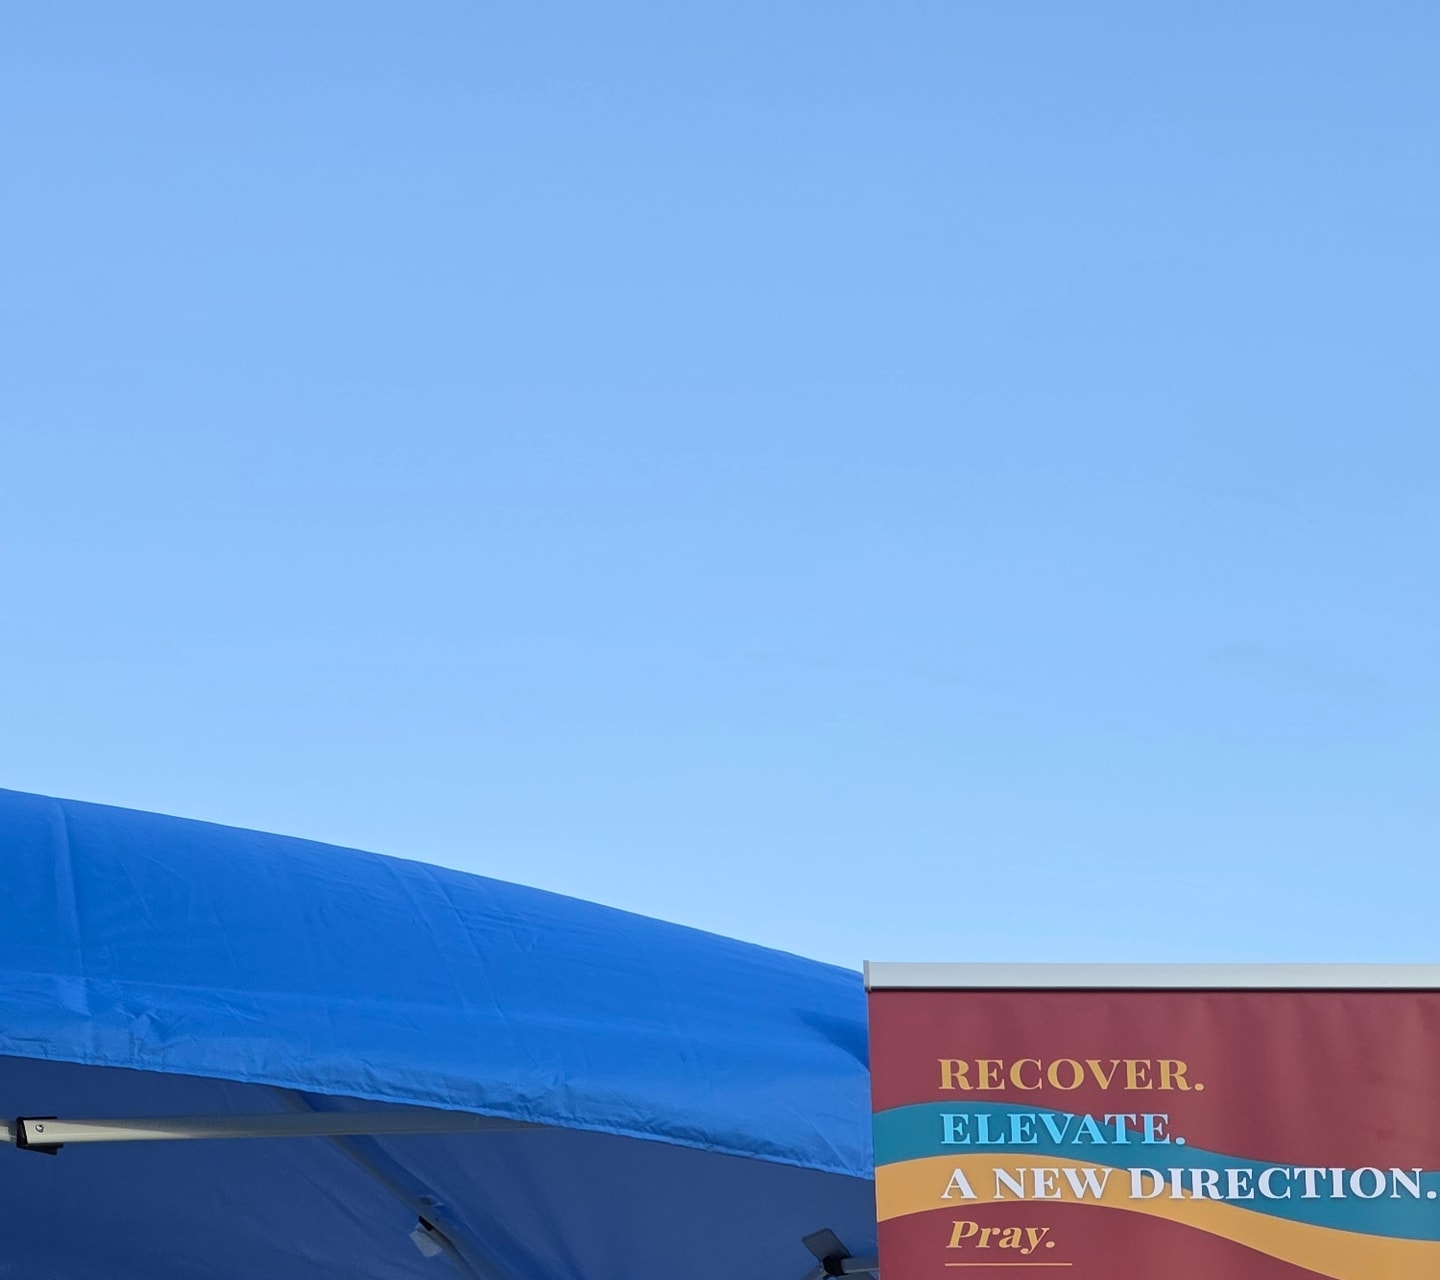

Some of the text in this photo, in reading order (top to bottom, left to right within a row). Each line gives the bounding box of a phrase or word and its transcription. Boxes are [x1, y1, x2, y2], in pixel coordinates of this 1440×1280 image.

[937, 1058, 1205, 1092] RECOVER.
[939, 1113, 1186, 1146] ELEVATE.
[940, 1168, 1437, 1201] A NEW DIRECTION.
[947, 1220, 1056, 1254] Pray.
